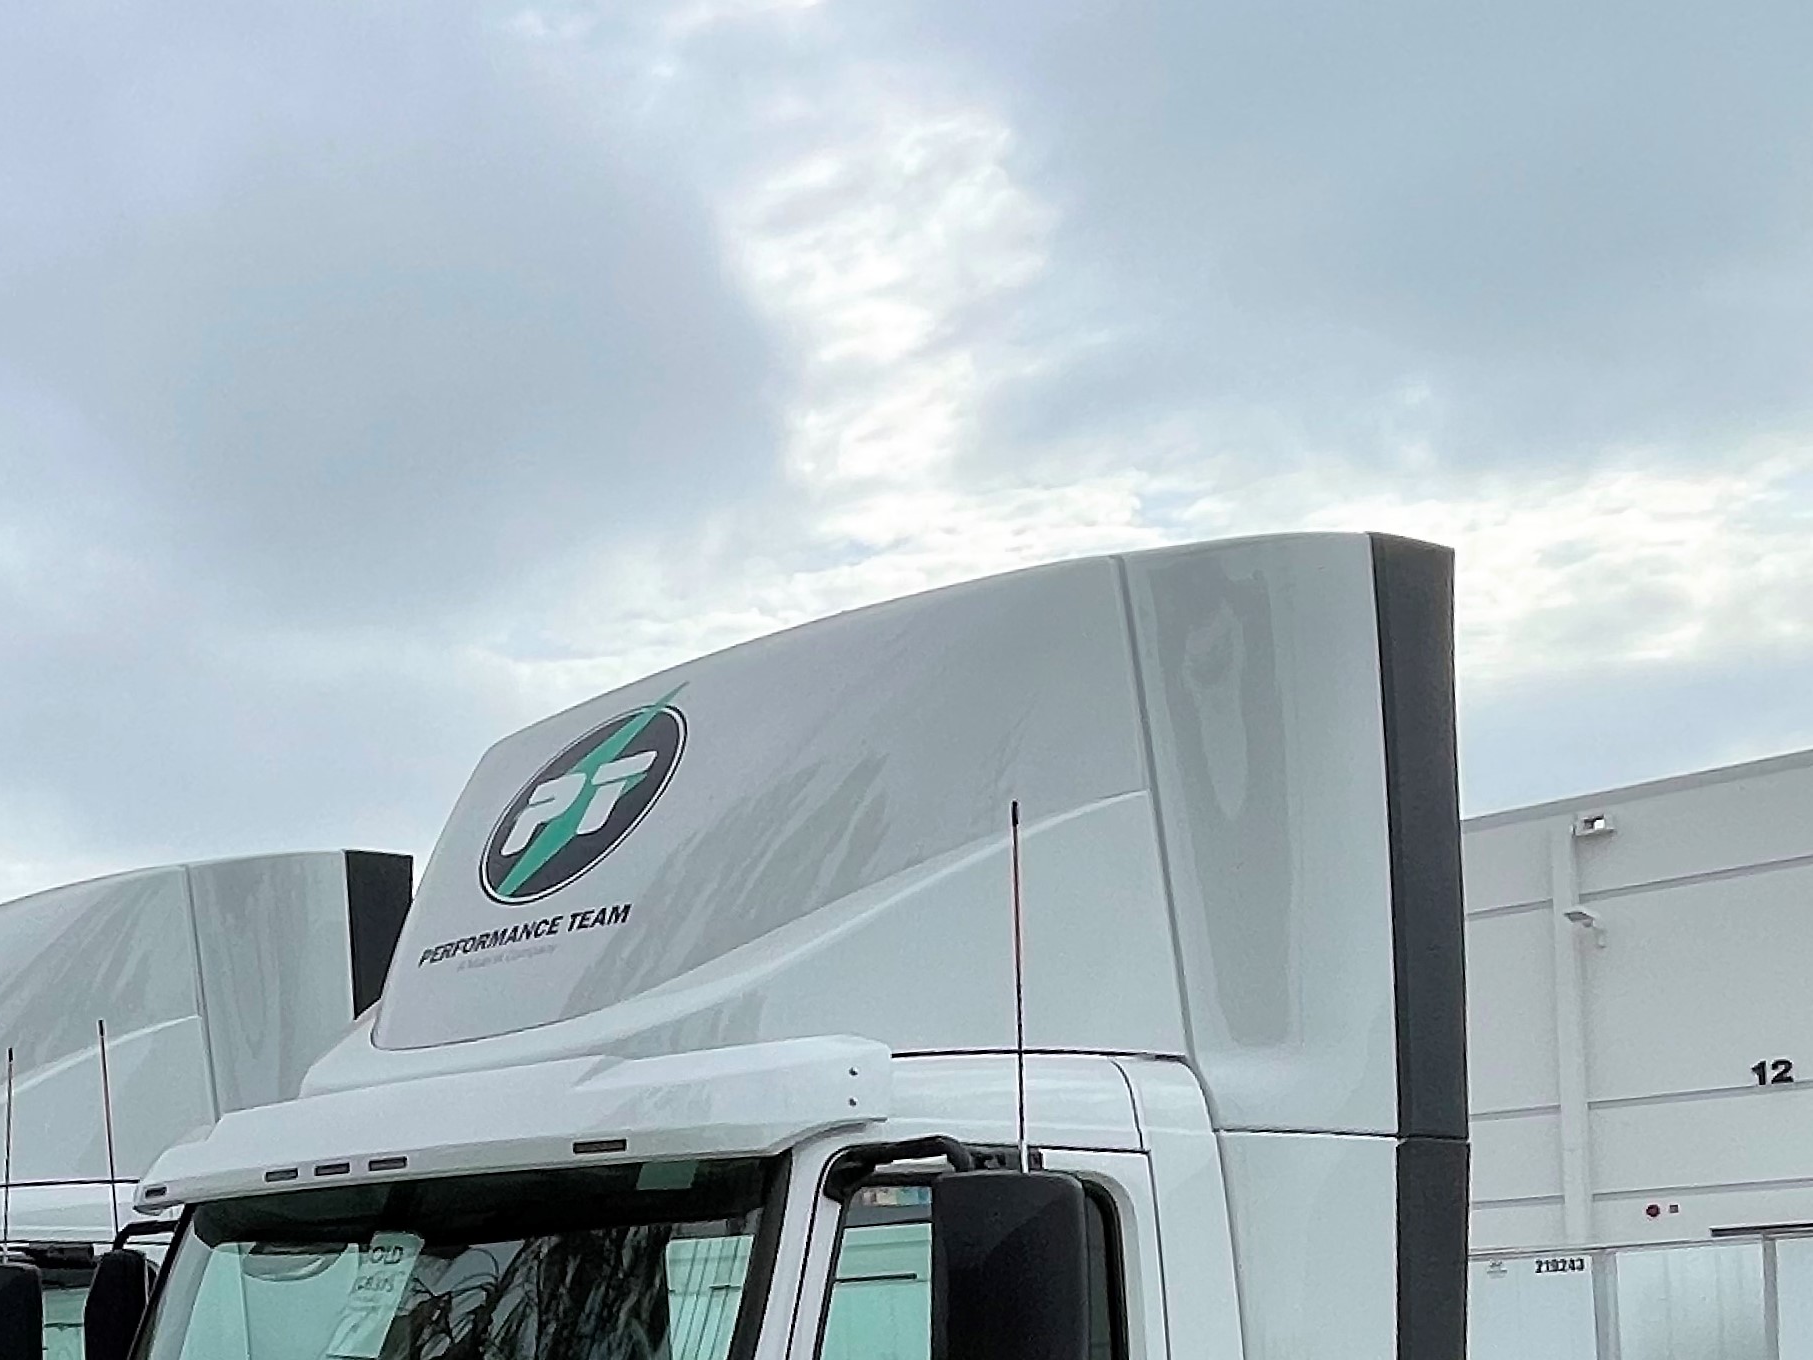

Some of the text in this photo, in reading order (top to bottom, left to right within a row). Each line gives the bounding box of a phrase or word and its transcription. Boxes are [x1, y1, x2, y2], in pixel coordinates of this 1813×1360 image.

[418, 915, 563, 968] PERFORMANCE
[568, 903, 632, 932] TEAM
[1750, 1058, 1796, 1086] 12
